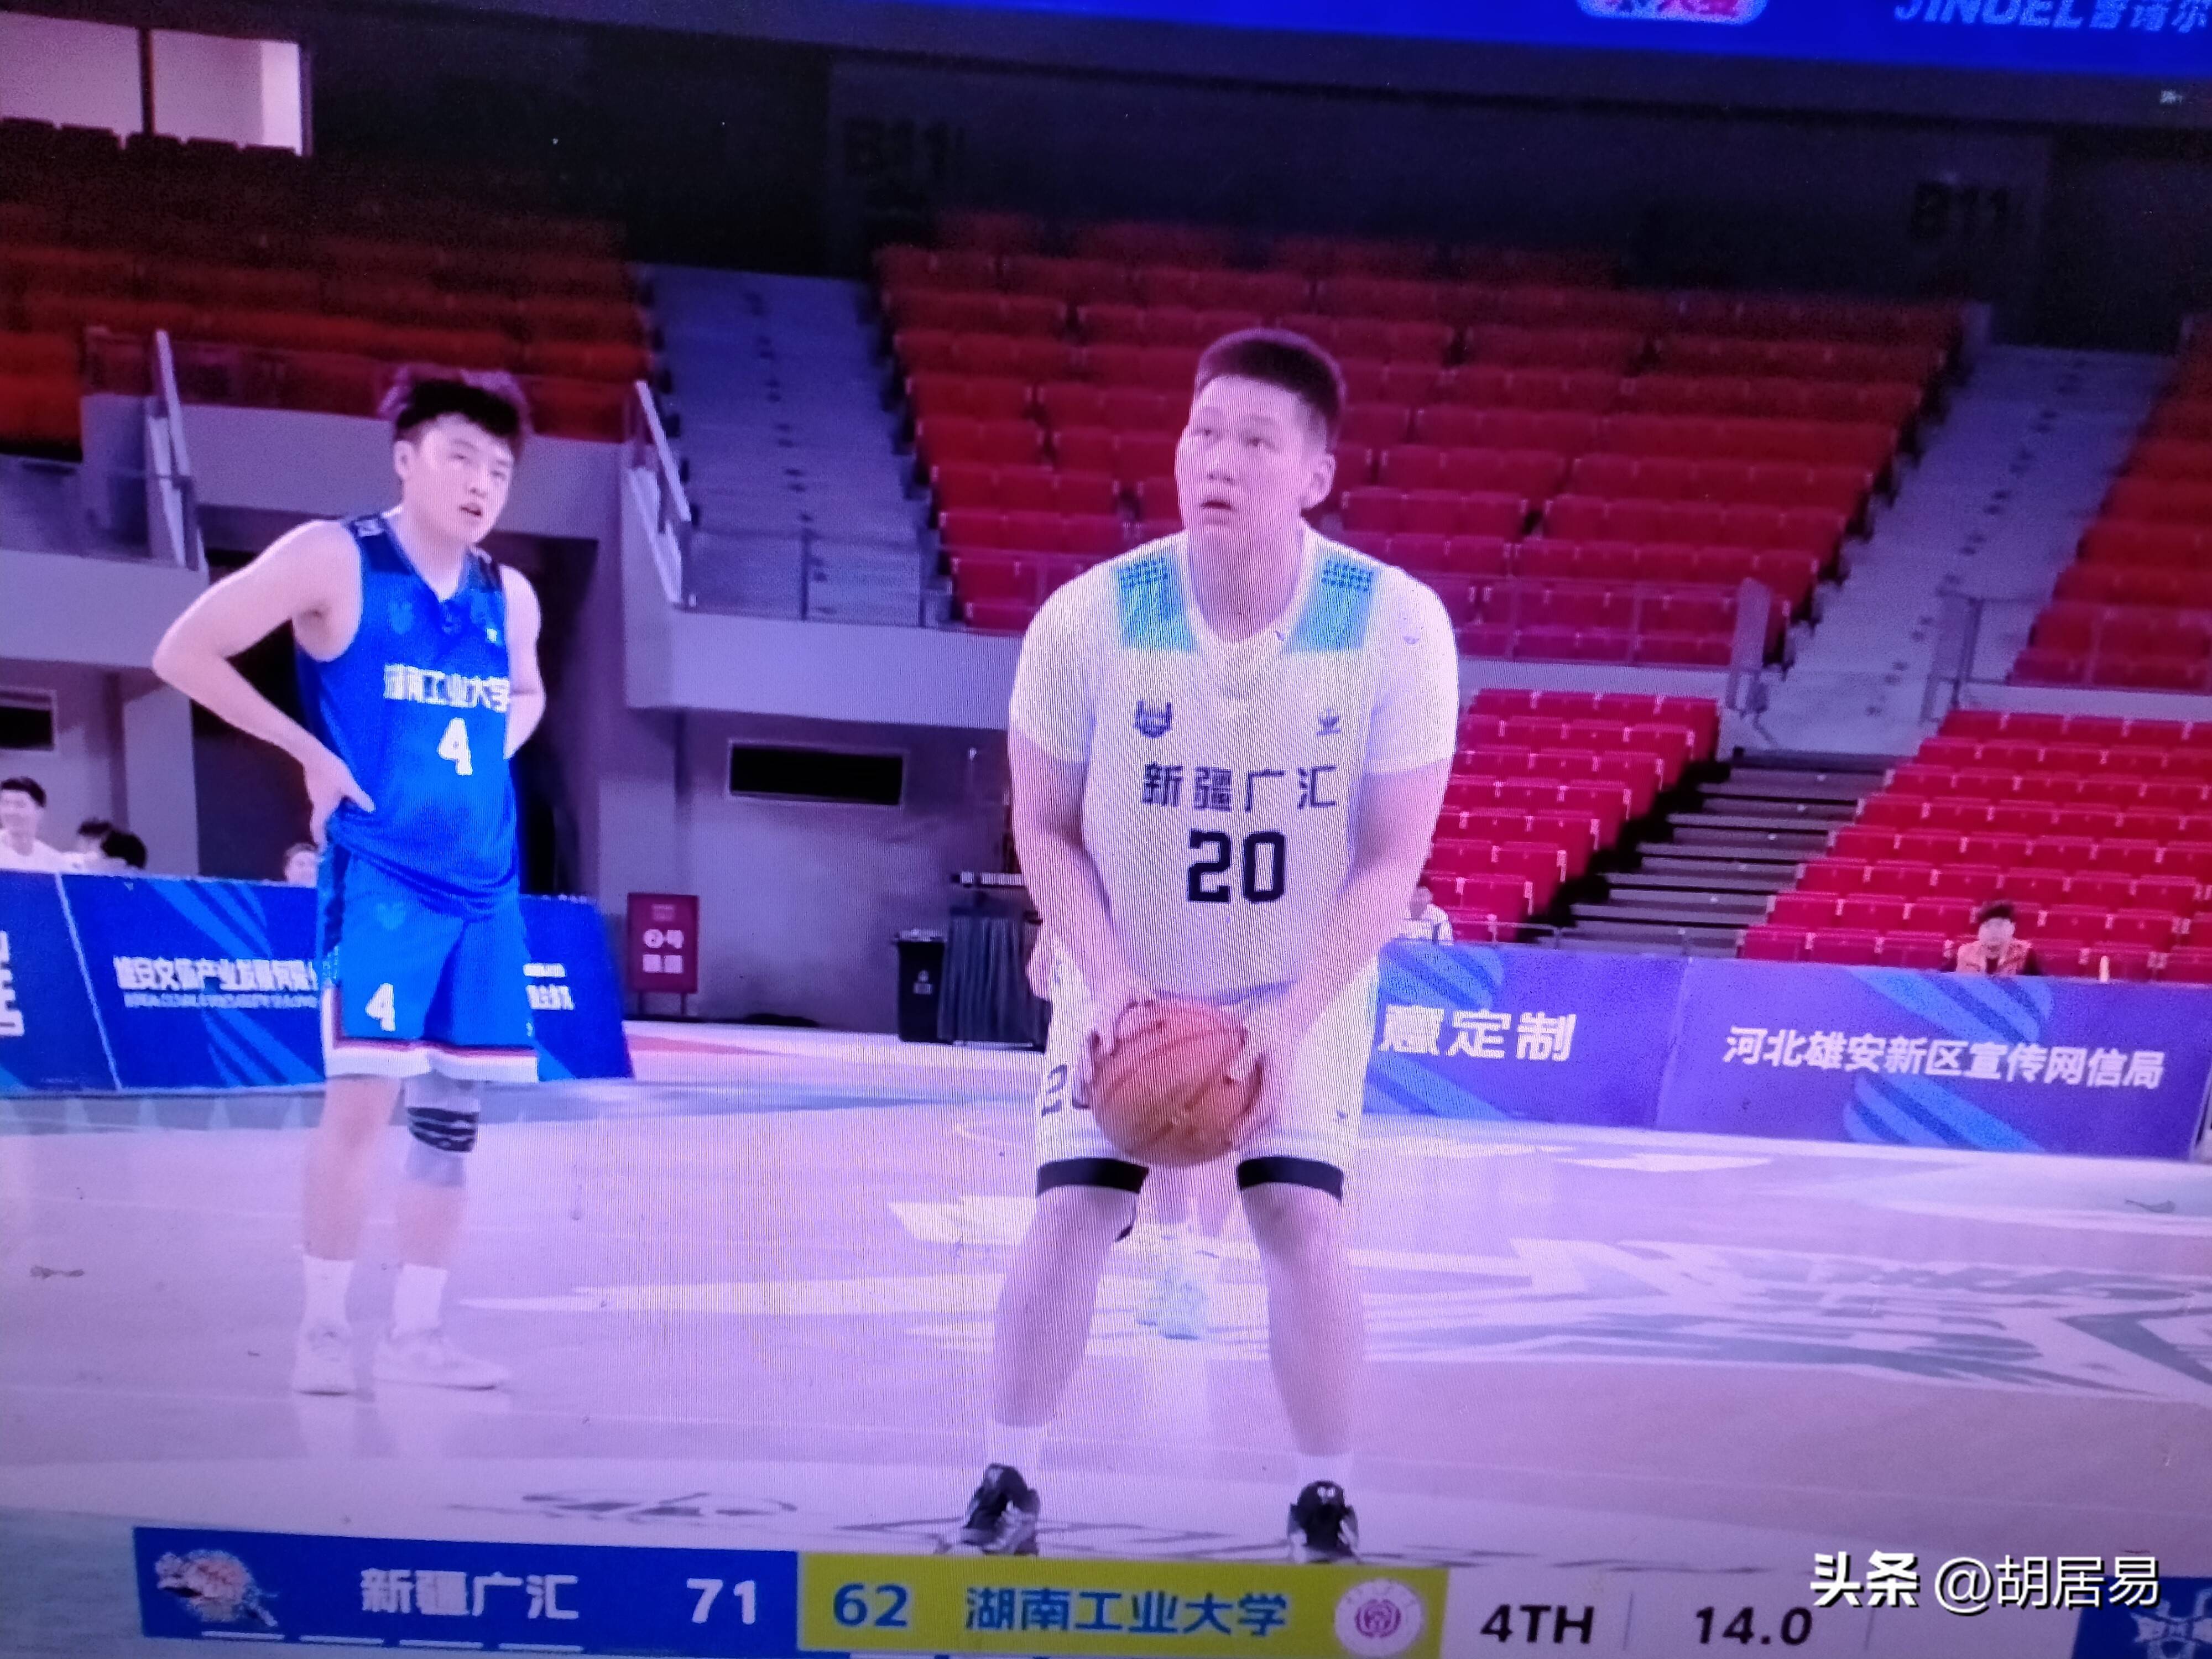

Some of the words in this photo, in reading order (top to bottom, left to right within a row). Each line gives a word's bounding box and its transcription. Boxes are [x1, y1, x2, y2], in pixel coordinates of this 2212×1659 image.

[439, 717, 473, 775] 4
[1142, 763, 1337, 812] 新疆广汇
[1188, 830, 1285, 903] 20
[365, 983, 395, 1031] 4
[1721, 1024, 2166, 1089] 河北雄安新区宣传网信局
[360, 1568, 578, 1619] 新疆广汇
[687, 1578, 756, 1624] 71
[833, 1583, 908, 1627] 62
[965, 1587, 1288, 1638] 湖南工业大学
[1480, 1604, 1595, 1645] 4TH
[1695, 1606, 1813, 1646] 14.0
